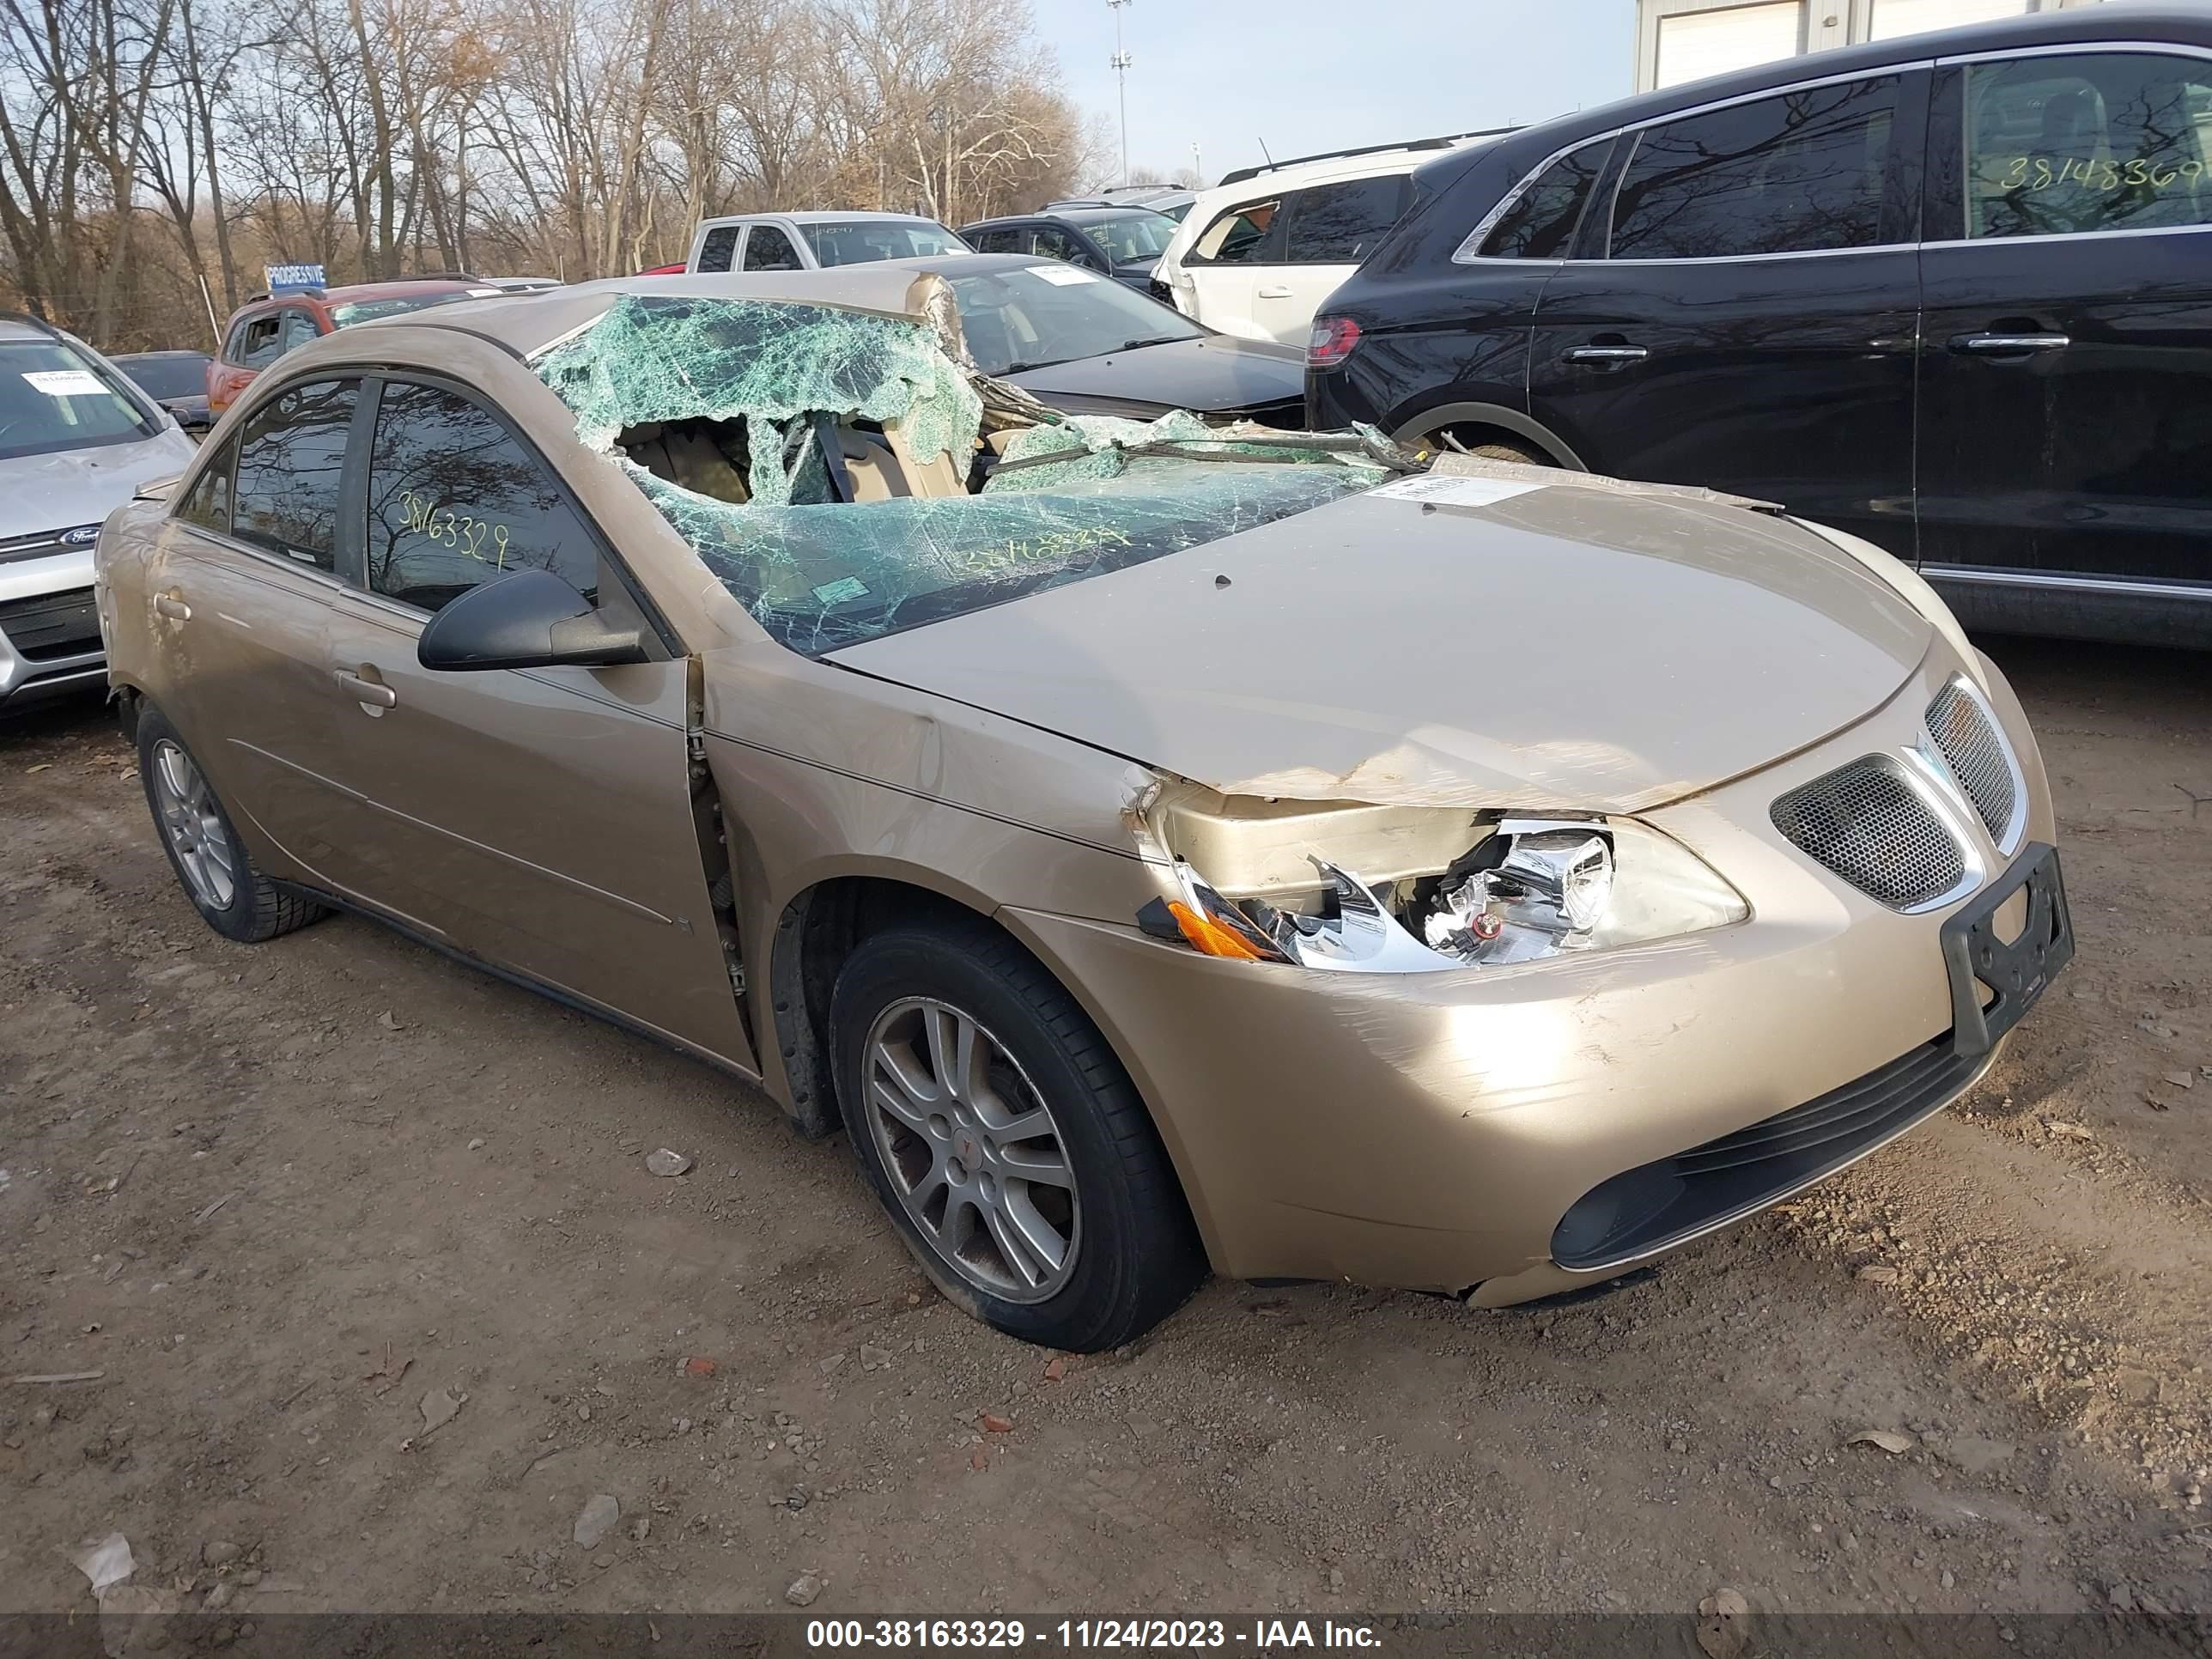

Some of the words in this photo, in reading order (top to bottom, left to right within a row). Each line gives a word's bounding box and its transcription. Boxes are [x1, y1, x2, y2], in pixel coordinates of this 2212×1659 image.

[2001, 157, 2203, 191] 38148369
[267, 264, 326, 285] PROGRESSIVE
[397, 491, 510, 575] 38163329
